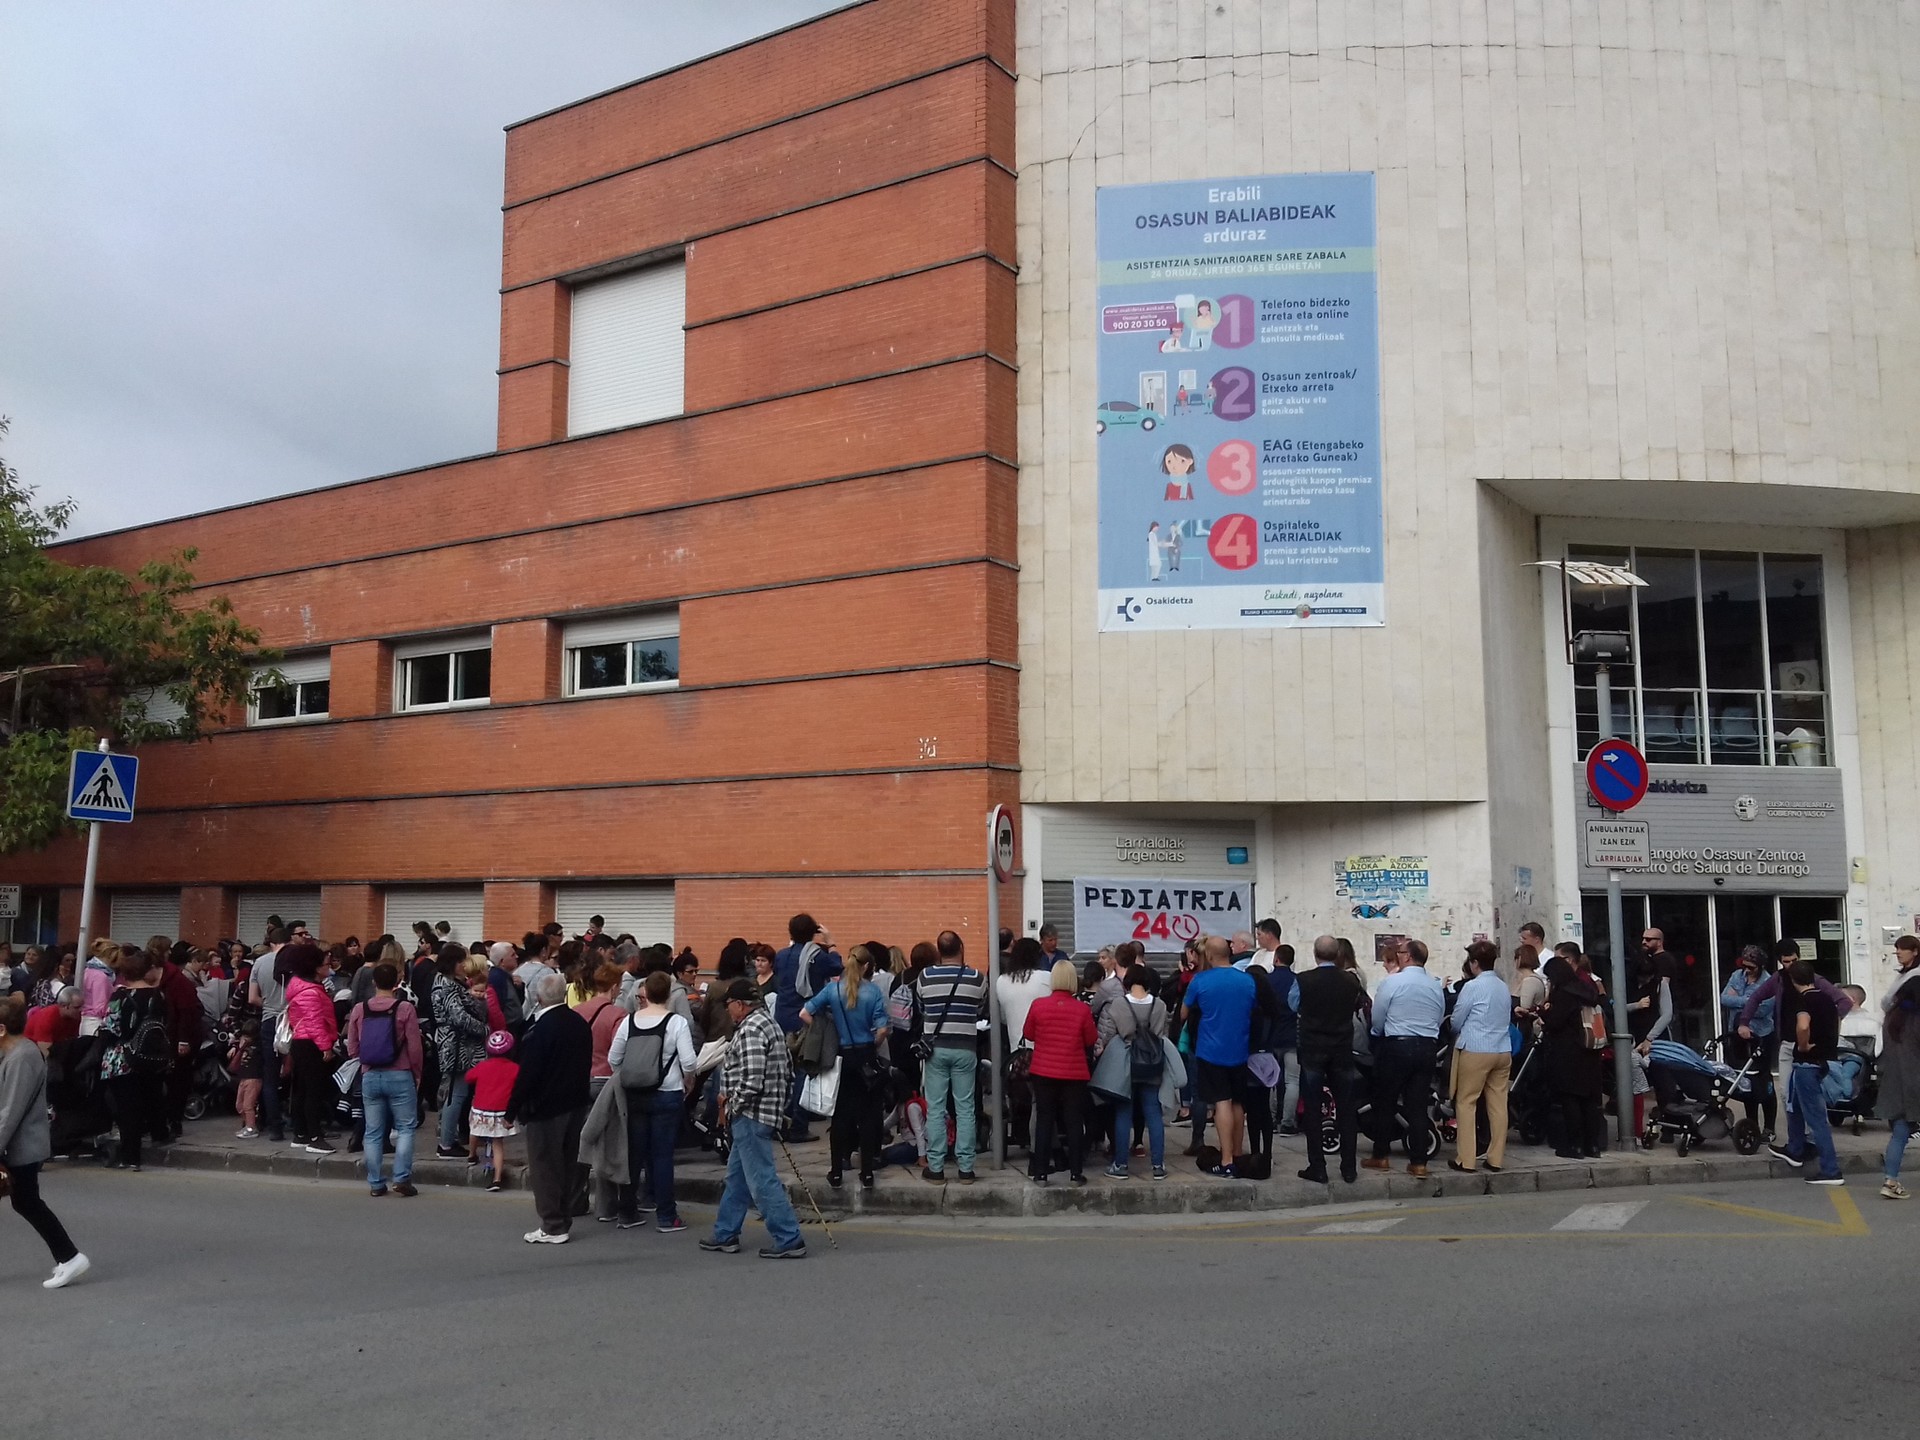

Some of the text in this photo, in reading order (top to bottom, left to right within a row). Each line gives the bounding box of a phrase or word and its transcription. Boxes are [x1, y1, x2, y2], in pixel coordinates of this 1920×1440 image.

[1209, 186, 1260, 202] Erabili
[1135, 204, 1336, 229] OSASUN BALIABIDEAK
[1203, 228, 1267, 243] arduraz
[1126, 250, 1346, 270] ASISTENTZIA SANITARIOAREN SARE ZABALA
[1205, 264, 1244, 276] URTEKO
[1248, 263, 1265, 273] 365
[1261, 297, 1350, 309] Telefono bidezko
[1221, 299, 1240, 343] 1
[1261, 309, 1349, 321] arreta eta online
[1112, 318, 1167, 330] 900 20 30 50
[1261, 323, 1319, 333] zalantzak eta
[1261, 332, 1345, 343] kontsulta medikoak
[1262, 368, 1357, 381] Osasun zentroak/
[1221, 369, 1250, 413] 2
[1262, 382, 1334, 393] Etxeko arreta
[1312, 396, 1327, 404] eta
[1262, 407, 1304, 416] kronikoak
[1262, 439, 1364, 451] EAG (Etengabeko
[1262, 451, 1358, 463] Arretako Guneak)
[1219, 443, 1252, 490] 3
[1262, 467, 1342, 476] osasun-zentroaren
[1310, 476, 1336, 486] kanpo
[1338, 475, 1372, 485] premiaz
[1263, 486, 1355, 496] artatu beharreko kasu
[1263, 520, 1320, 532] Ospitaleko
[1214, 516, 1251, 567] 4
[1264, 531, 1342, 542] LARRIALDIAK
[1264, 544, 1371, 556] premiaz artatu beharreko
[1264, 557, 1284, 565] kasu
[1146, 597, 1194, 605] Osakidetza
[1264, 589, 1344, 602] Euskadi, auzolana
[1648, 780, 1708, 793] akidetza
[1589, 825, 1645, 834] ANBULANTZIAK
[1116, 836, 1185, 849] Larrialdiak
[1600, 838, 1636, 846] IZAN EZIK
[1117, 848, 1185, 864] Urgencias
[1595, 855, 1643, 863] LARRIALDIAK
[1650, 847, 1806, 863] angoko Osasun Zentroa
[1350, 862, 1379, 870] AZOKA
[1390, 862, 1419, 870] AZOKA
[1672, 861, 1689, 874] de
[1694, 861, 1731, 874] Salud
[1736, 861, 1753, 874] de
[1757, 861, 1810, 877] Durango
[1350, 870, 1385, 879] OUTLET
[1389, 878, 1426, 886] NGAK
[1084, 886, 1242, 911] PEDIATRIA
[1131, 911, 1171, 940] 24
